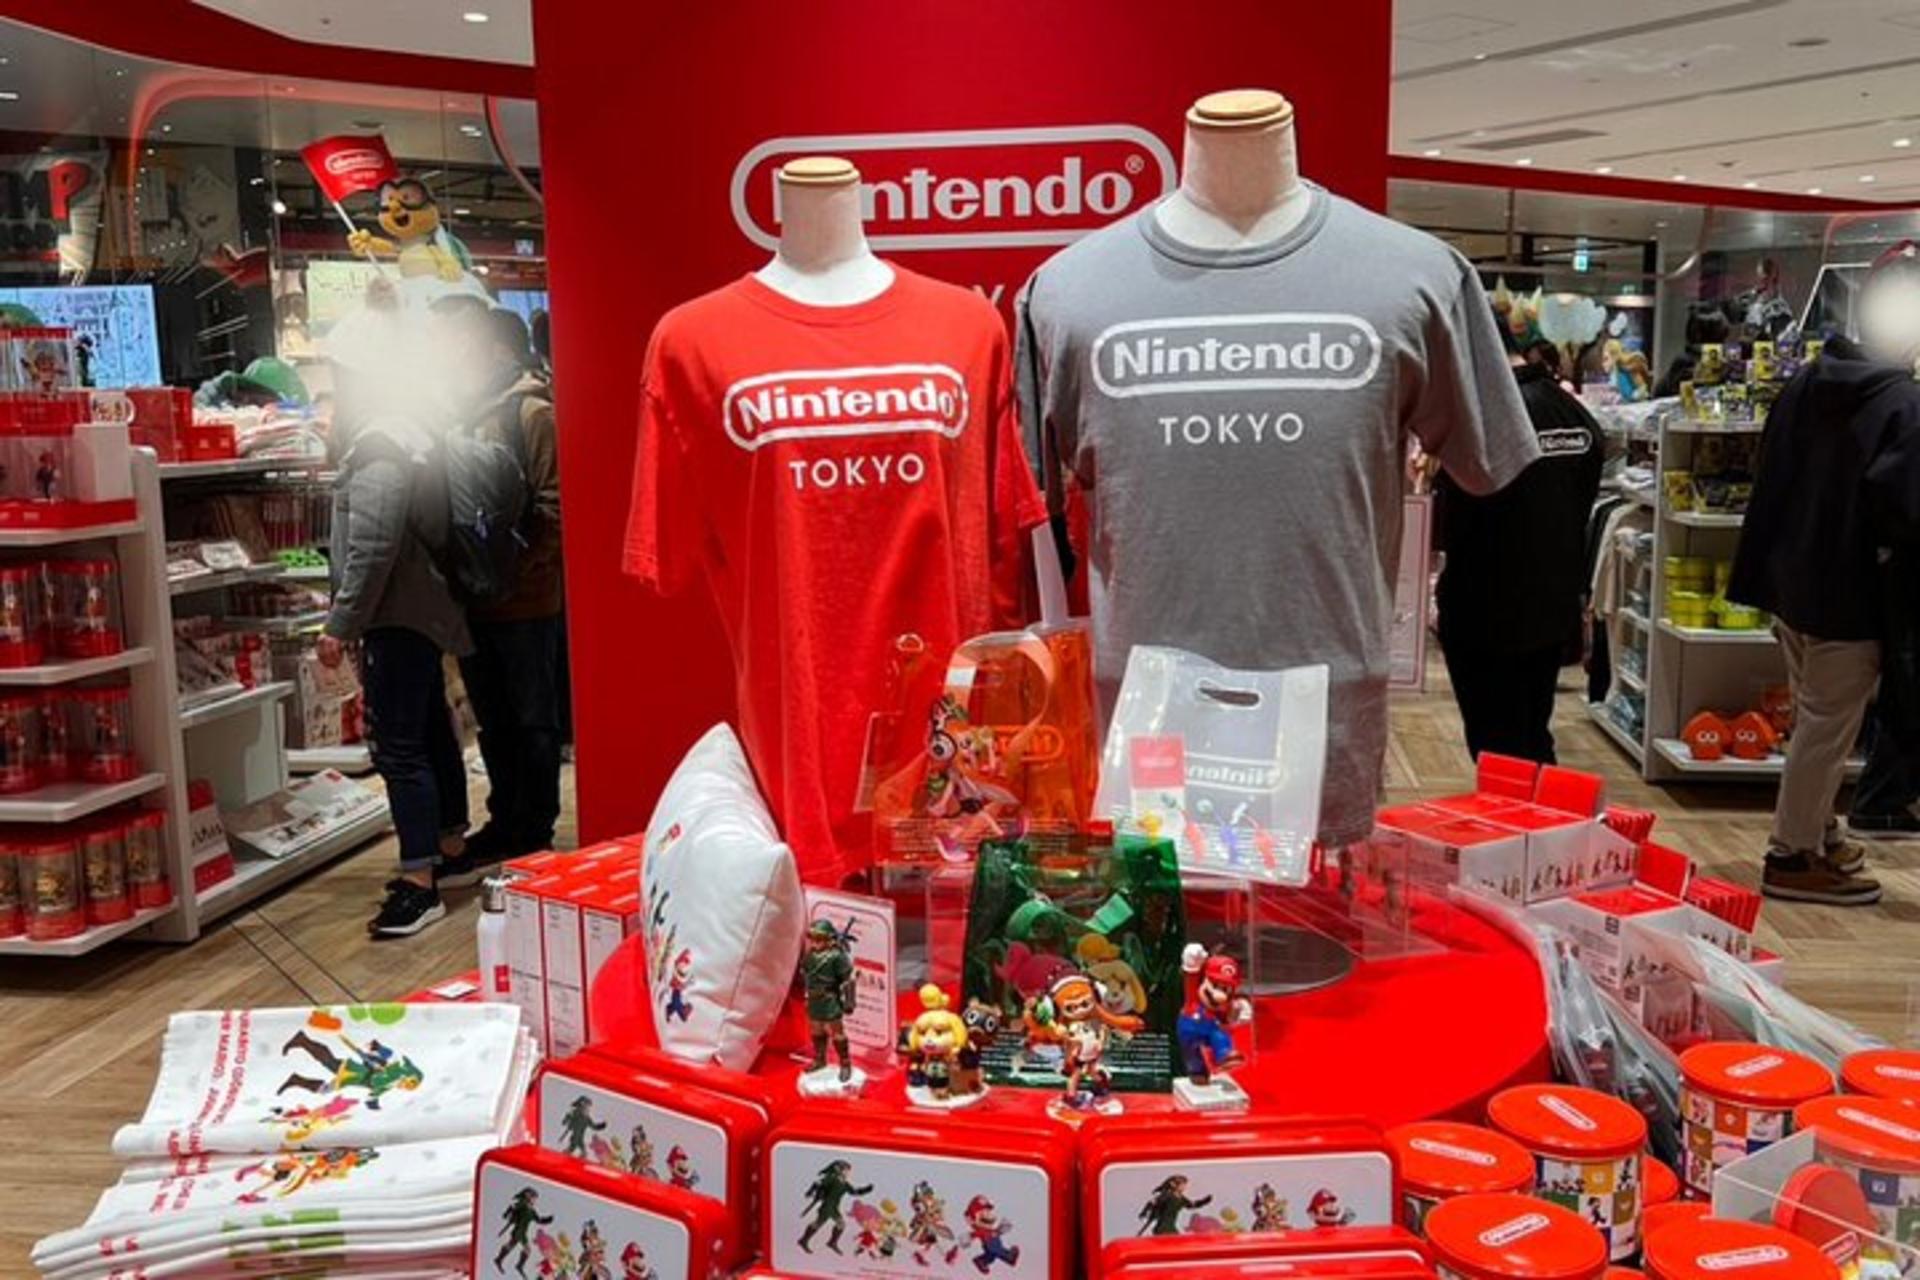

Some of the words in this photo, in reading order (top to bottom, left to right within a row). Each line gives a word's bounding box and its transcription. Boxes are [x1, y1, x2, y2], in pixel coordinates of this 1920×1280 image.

[773, 156, 1132, 224] ntendo
[1112, 332, 1355, 380] Nintendo
[737, 378, 954, 433] Nintendo
[1158, 412, 1304, 446] TOKYO
[788, 453, 924, 490] TOKYO
